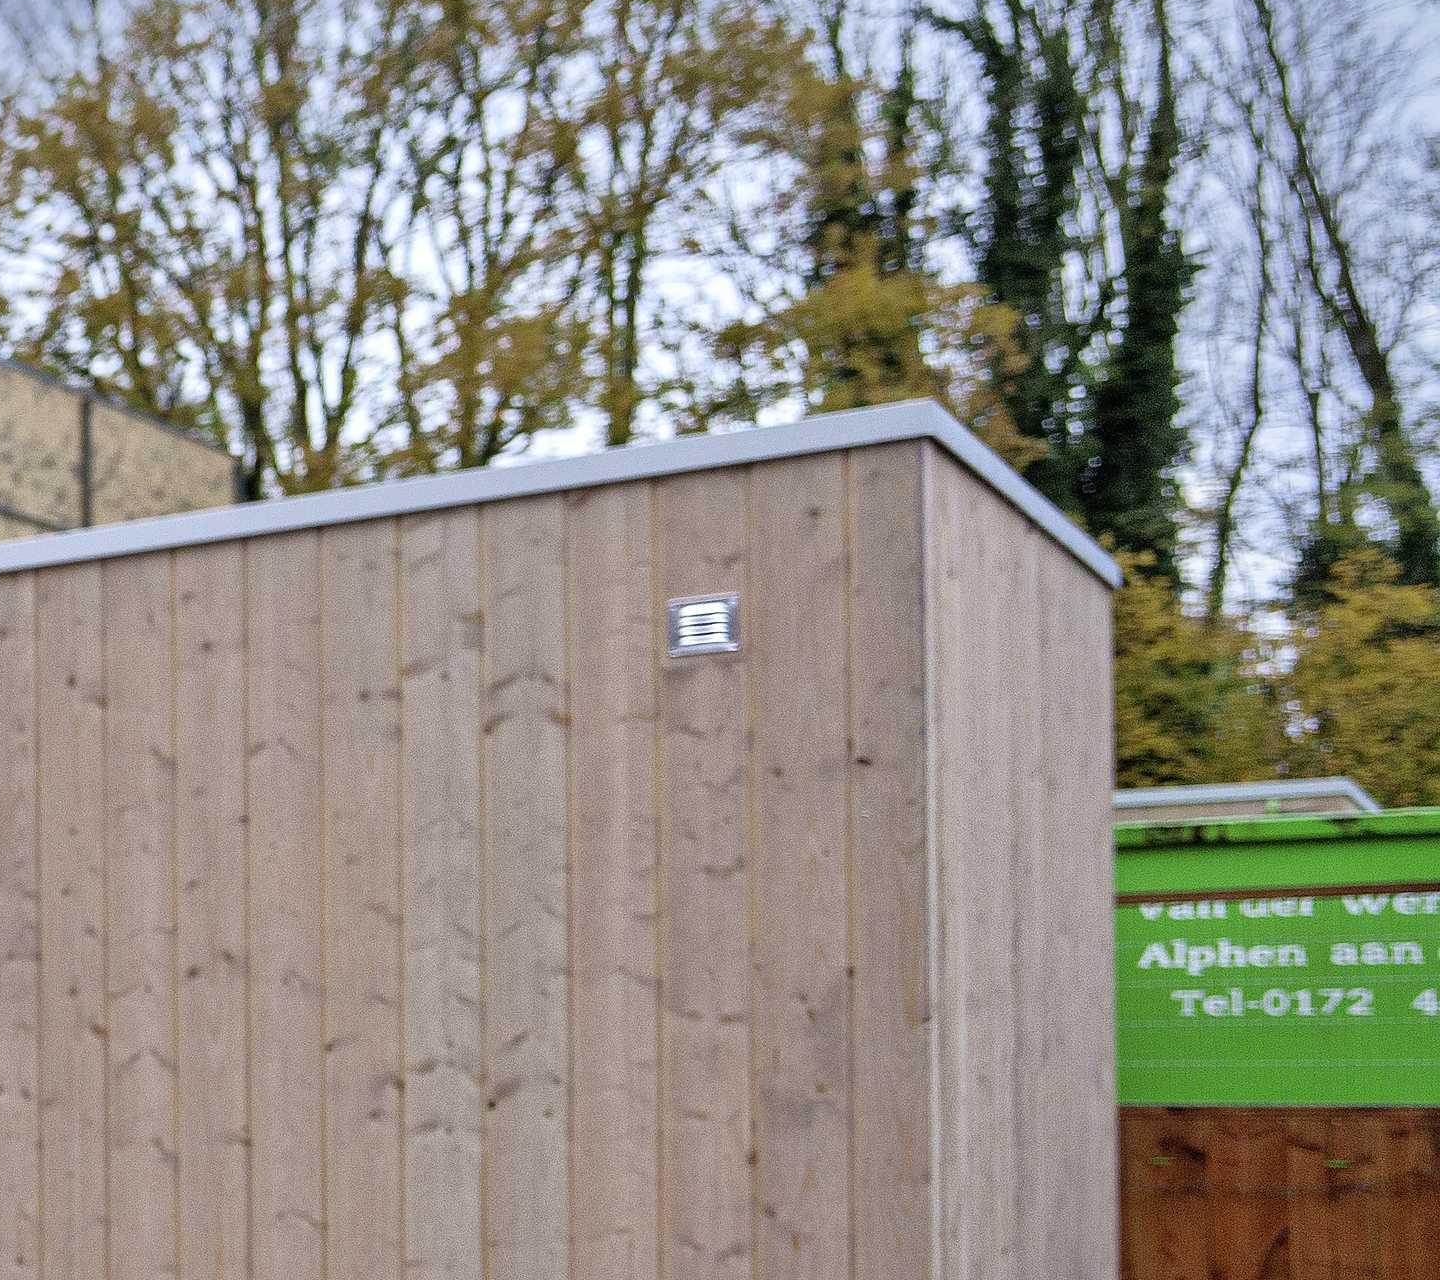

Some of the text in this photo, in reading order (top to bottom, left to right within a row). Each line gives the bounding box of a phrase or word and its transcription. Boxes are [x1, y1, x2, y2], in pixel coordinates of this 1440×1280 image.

[1138, 938, 1424, 976] Alphen aan
[1171, 987, 1377, 1017] Tel-0172
